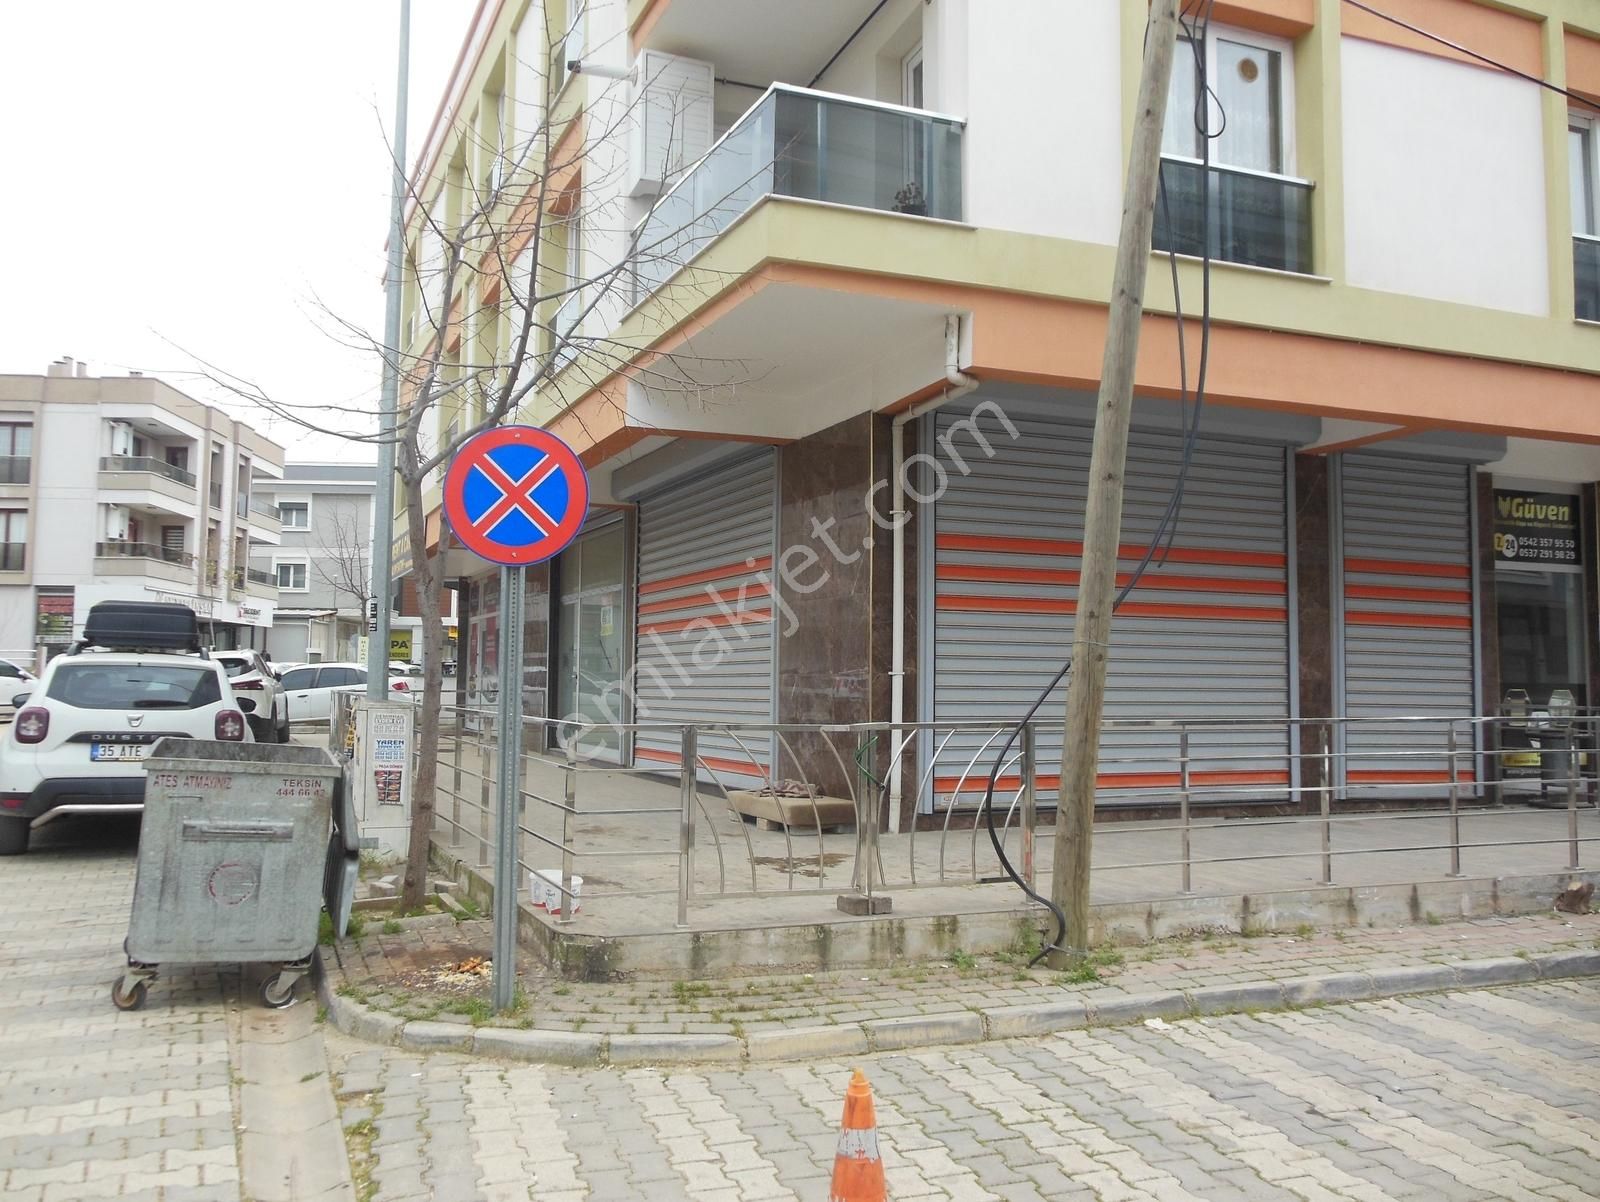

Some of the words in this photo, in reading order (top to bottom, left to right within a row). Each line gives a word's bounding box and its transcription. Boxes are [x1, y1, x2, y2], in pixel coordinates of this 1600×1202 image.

[1512, 498, 1569, 521] Güven
[1519, 537, 1538, 546] 0542
[1539, 538, 1553, 547] 357
[1519, 548, 1538, 557] 0537
[100, 745, 114, 757] 35
[120, 745, 142, 757] ATE
[276, 788, 295, 797] 444
